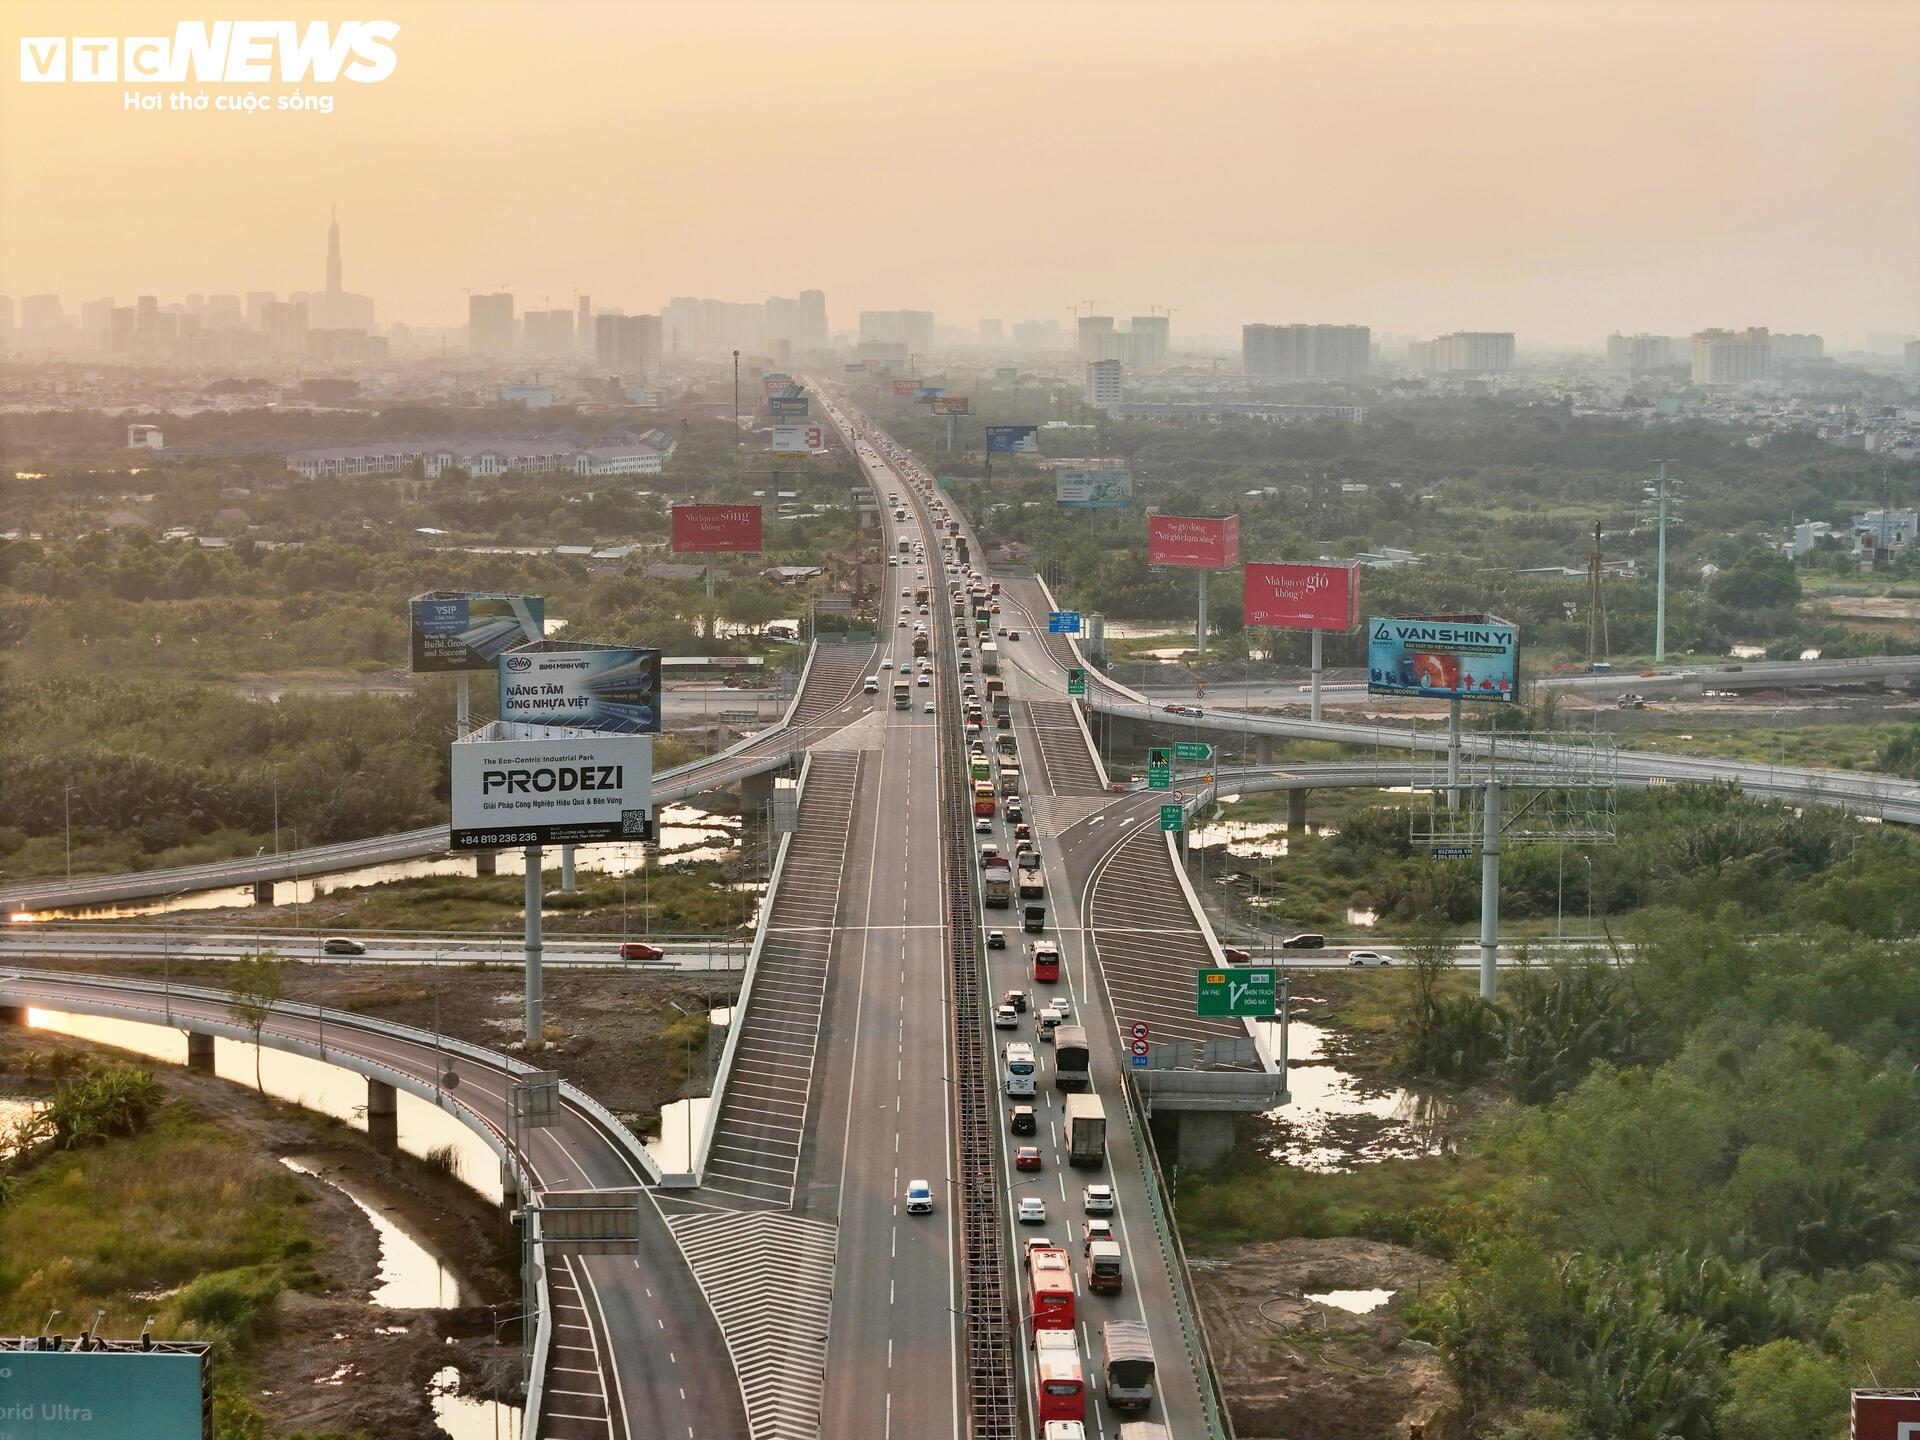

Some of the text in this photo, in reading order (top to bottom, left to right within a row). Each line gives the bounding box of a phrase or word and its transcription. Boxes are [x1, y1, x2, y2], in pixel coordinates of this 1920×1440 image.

[1305, 573, 1329, 594] gió
[1396, 627, 1512, 645] VAN SHIN YI
[447, 640, 466, 648] Grow
[438, 649, 467, 657] Succeed
[506, 682, 564, 696] NÂNG TẦM
[532, 698, 566, 710] NHỰA
[568, 696, 590, 709] VIỆT
[498, 756, 541, 765] Eco-Centric
[543, 754, 577, 762] Industrial
[483, 765, 623, 795] PRODEZI
[460, 833, 537, 845] +84 819 236 236
[41, 1403, 93, 1421] Ultra
